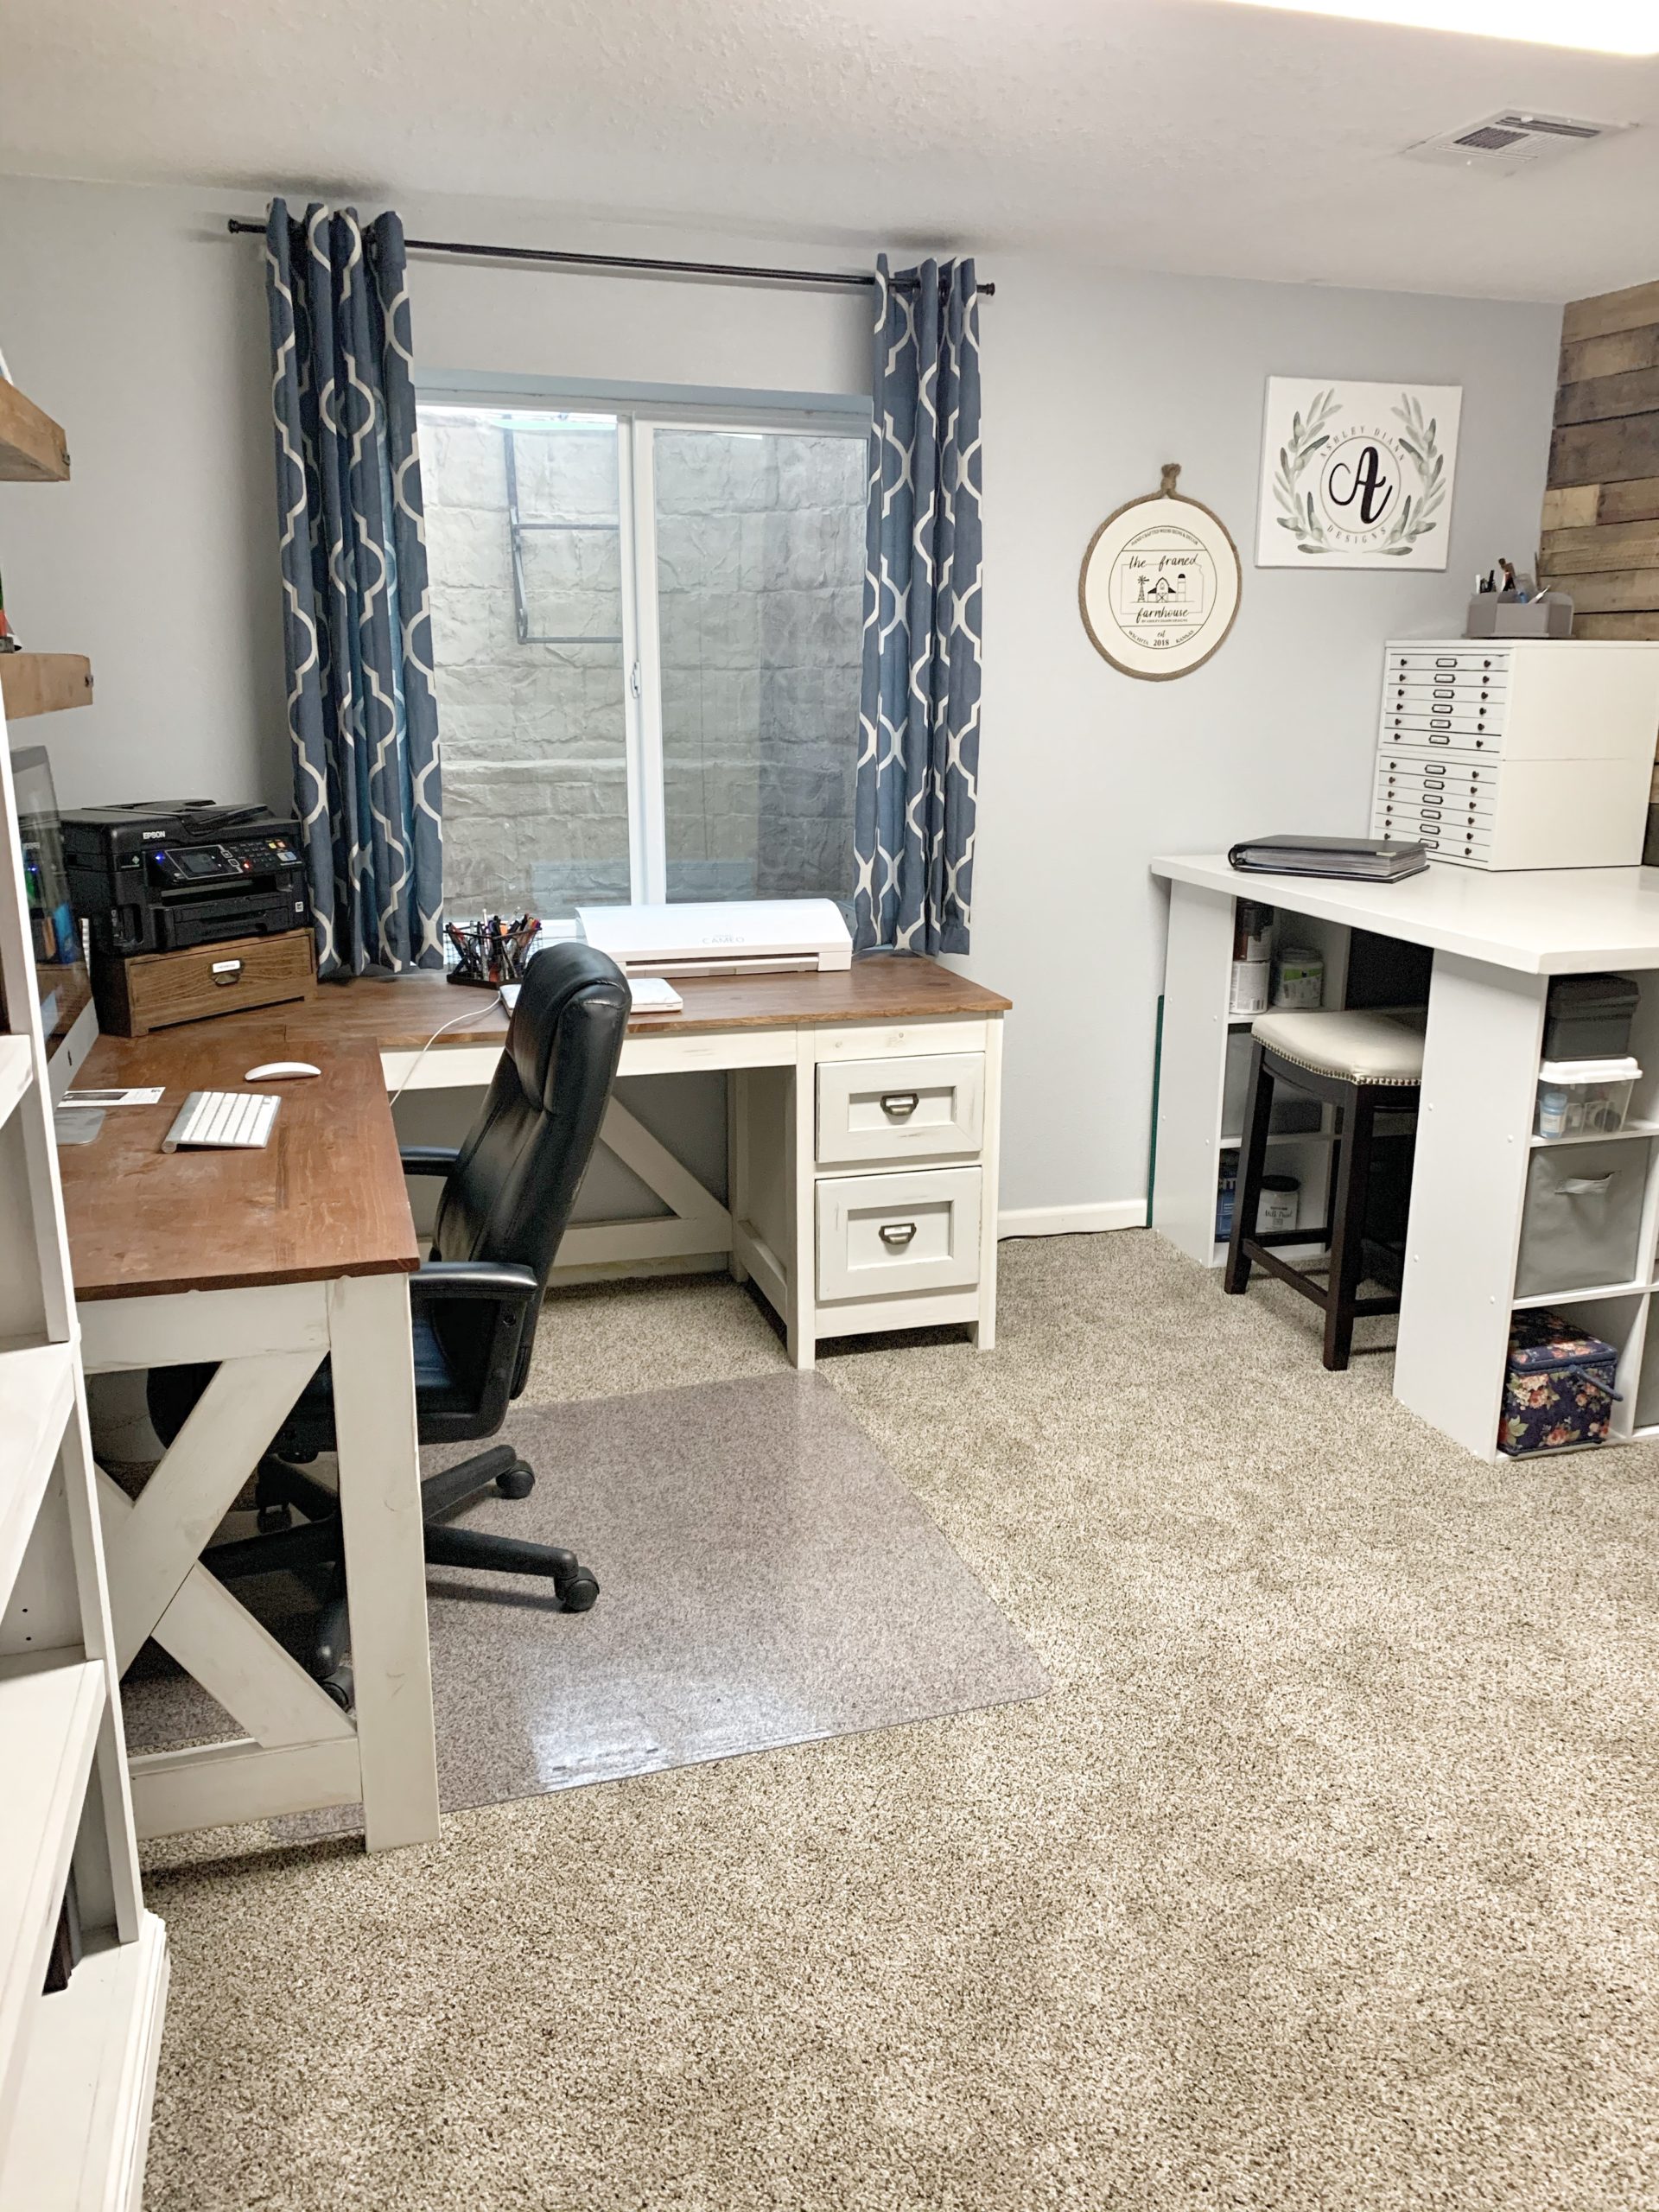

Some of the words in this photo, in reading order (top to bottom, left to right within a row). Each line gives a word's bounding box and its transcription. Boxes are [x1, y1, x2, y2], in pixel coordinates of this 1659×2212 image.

[1320, 427, 1365, 457] ASHLEY
[1374, 427, 1406, 461] DIANA
[1329, 446, 1394, 524] A
[1327, 525, 1386, 543] DESIGNS
[1128, 556, 1147, 569] the
[1158, 553, 1199, 572] framed
[1135, 606, 1190, 624] farmhouse
[1128, 630, 1149, 646] WICHITA
[1153, 639, 1170, 647] 2018
[142, 830, 167, 841] EPSON
[702, 936, 745, 944] CAMEO
